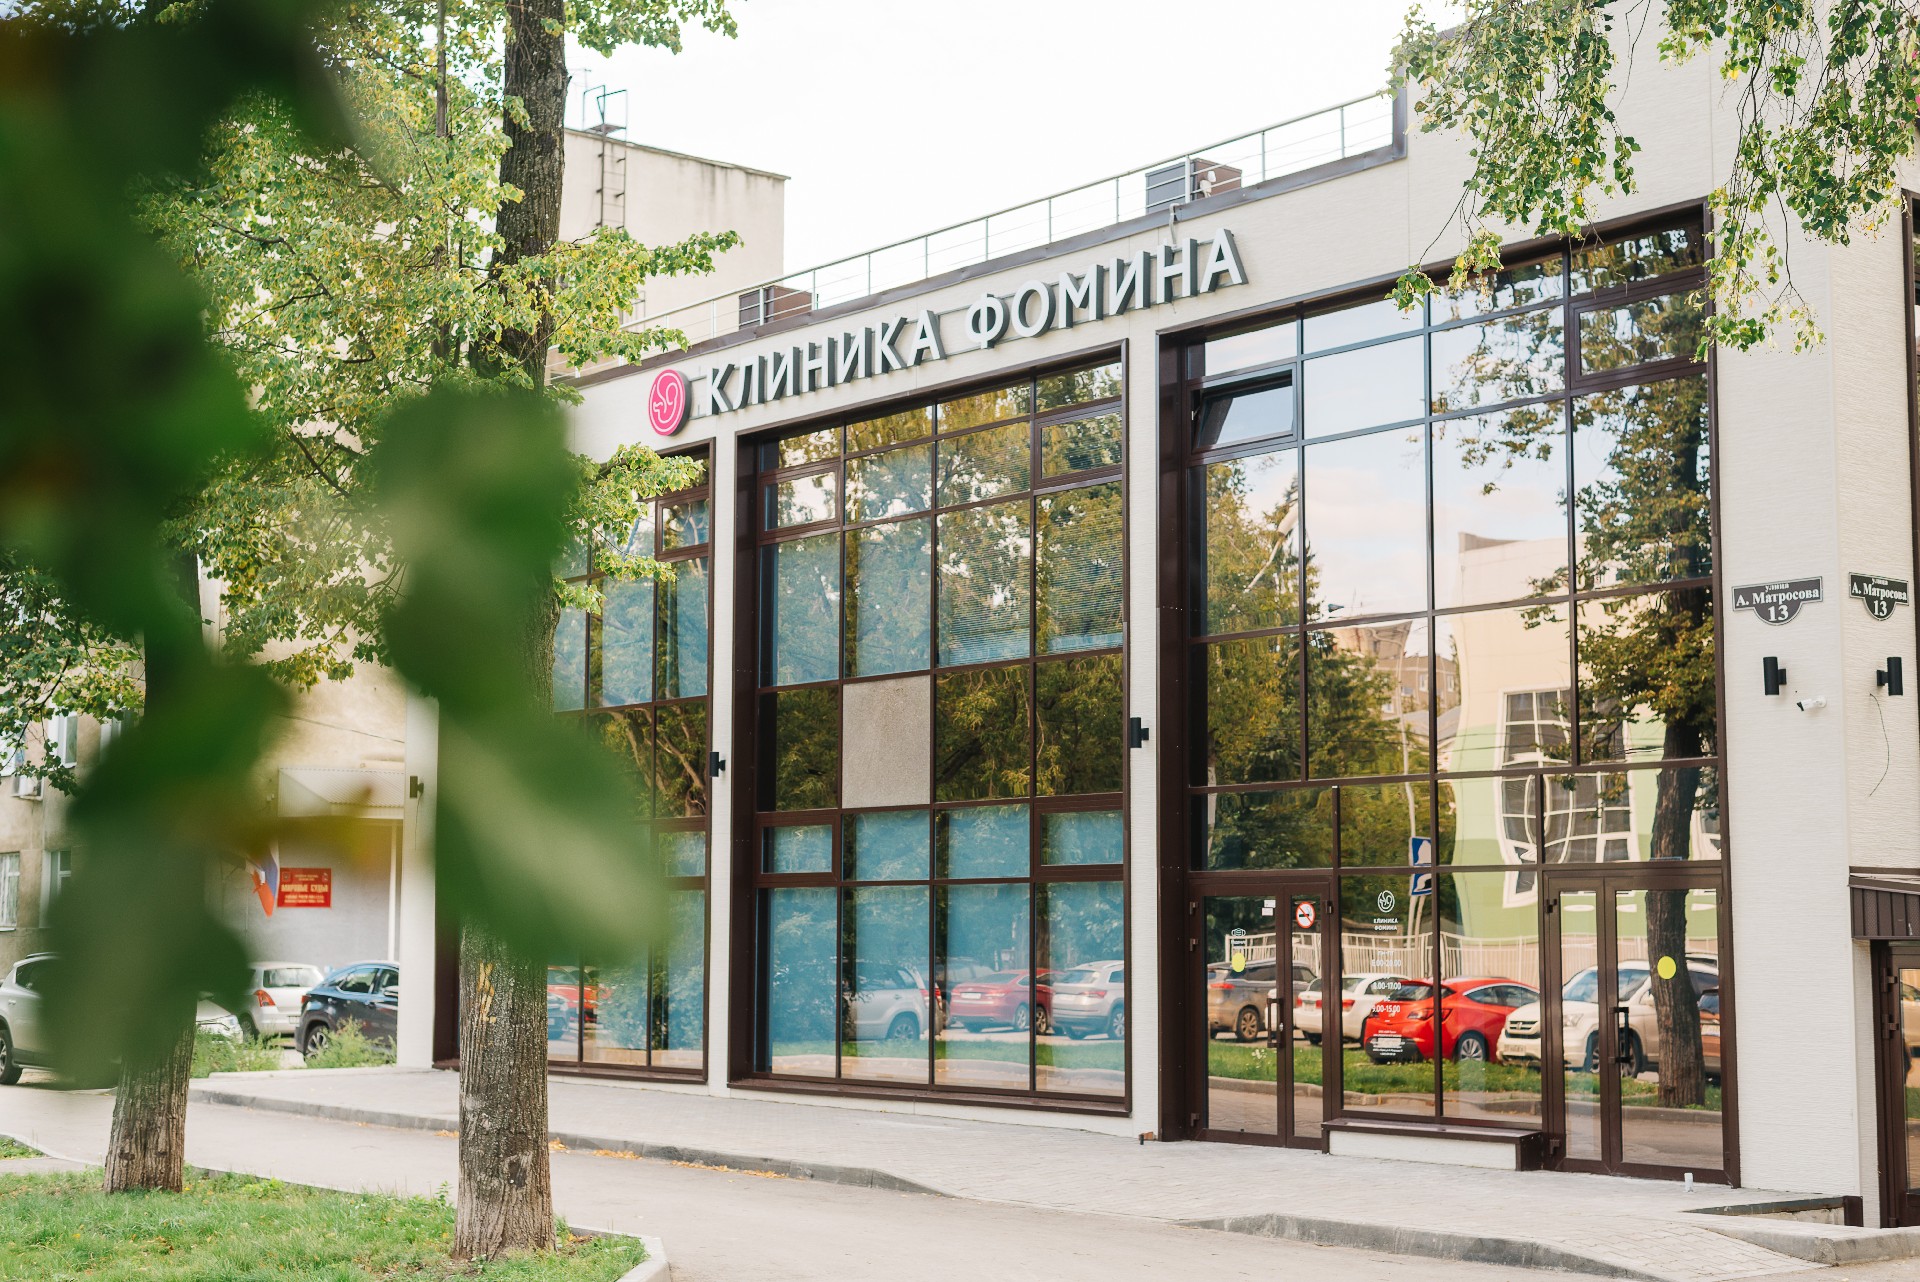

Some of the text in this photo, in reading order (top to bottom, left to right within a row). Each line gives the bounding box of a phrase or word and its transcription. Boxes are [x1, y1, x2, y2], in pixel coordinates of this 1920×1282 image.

[706, 228, 1249, 415] КЛИНИКА ФОМИНА
[1736, 588, 1819, 606] А. Матросова
[1852, 582, 1907, 600] А. Матросова
[1768, 604, 1789, 621] 13
[1874, 600, 1887, 616] 13
